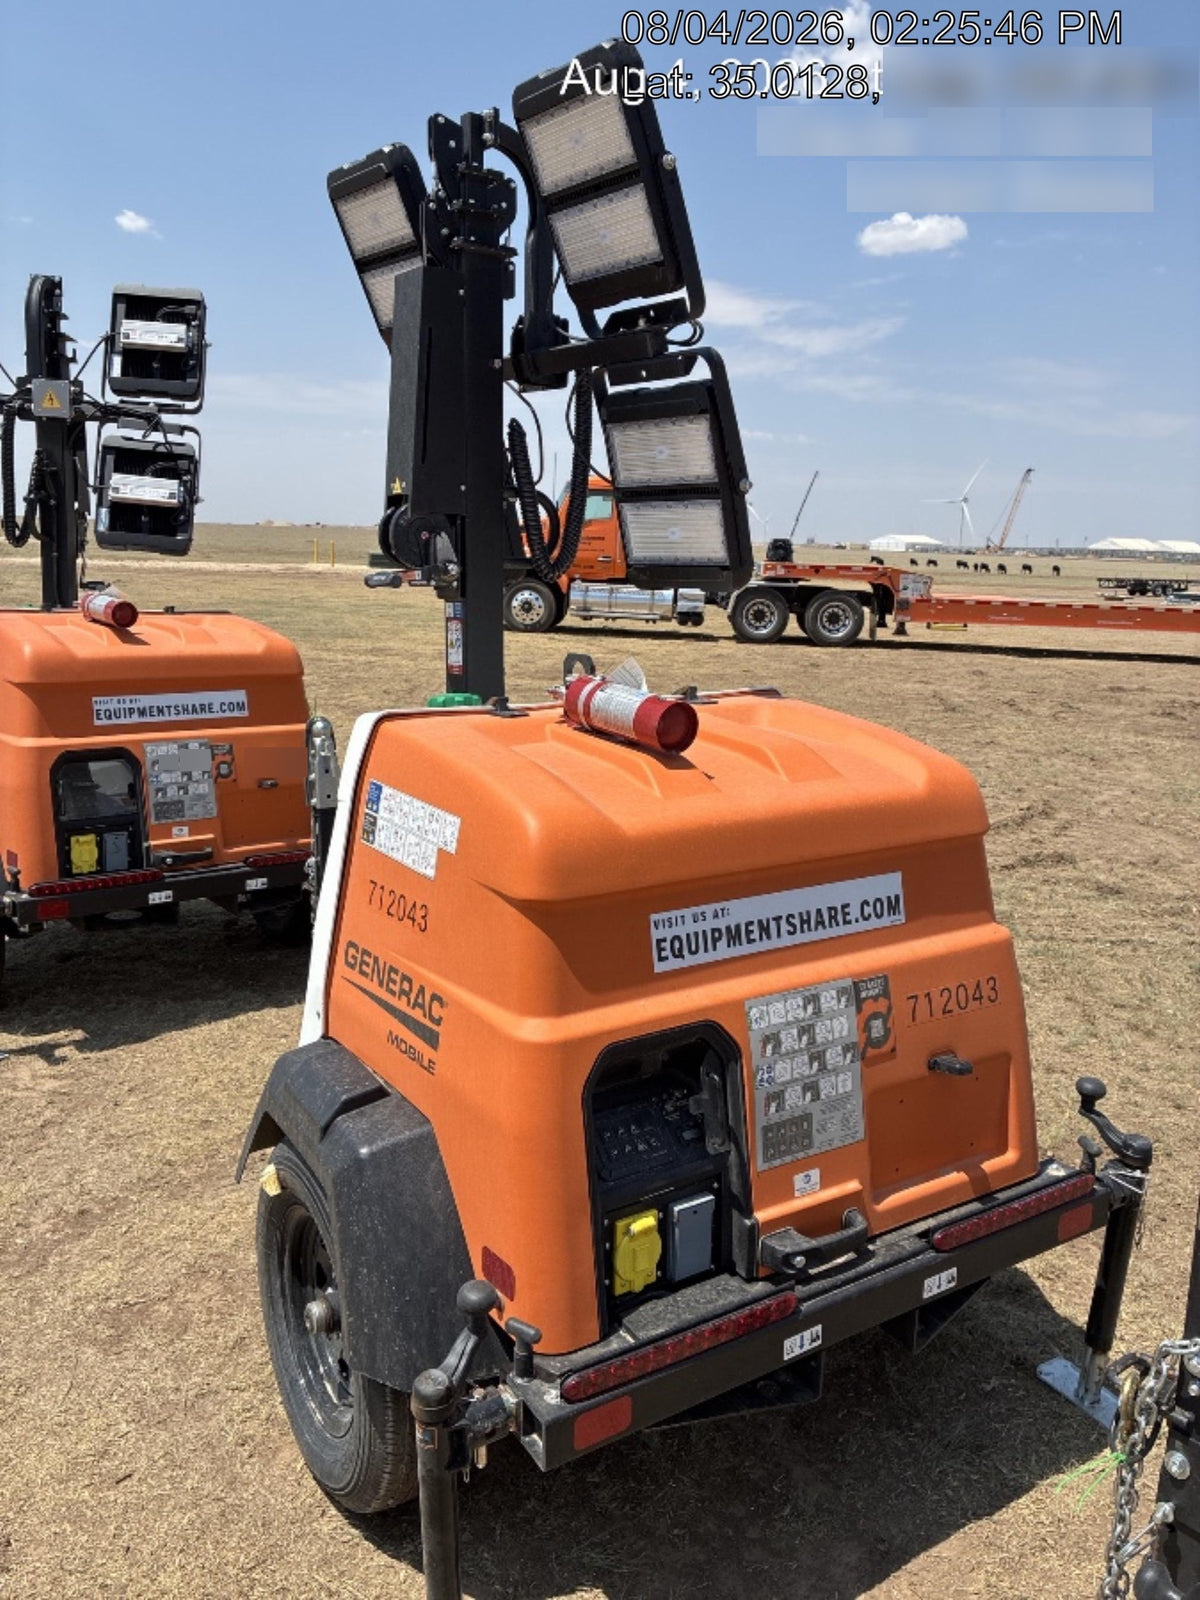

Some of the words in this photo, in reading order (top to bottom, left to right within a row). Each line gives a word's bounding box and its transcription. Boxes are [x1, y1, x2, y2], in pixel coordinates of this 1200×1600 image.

[95, 701, 246, 721] EQUIPMENTSHARE.COM
[368, 880, 430, 933] 712043
[653, 915, 686, 930] VISIT
[692, 911, 707, 924] US
[712, 906, 731, 920] AT:
[655, 894, 902, 963] EQUIPMENTSHARE.COM
[344, 940, 444, 1027] GENERAC
[906, 976, 1000, 1023] 712043
[387, 1029, 437, 1077] MOBILE
